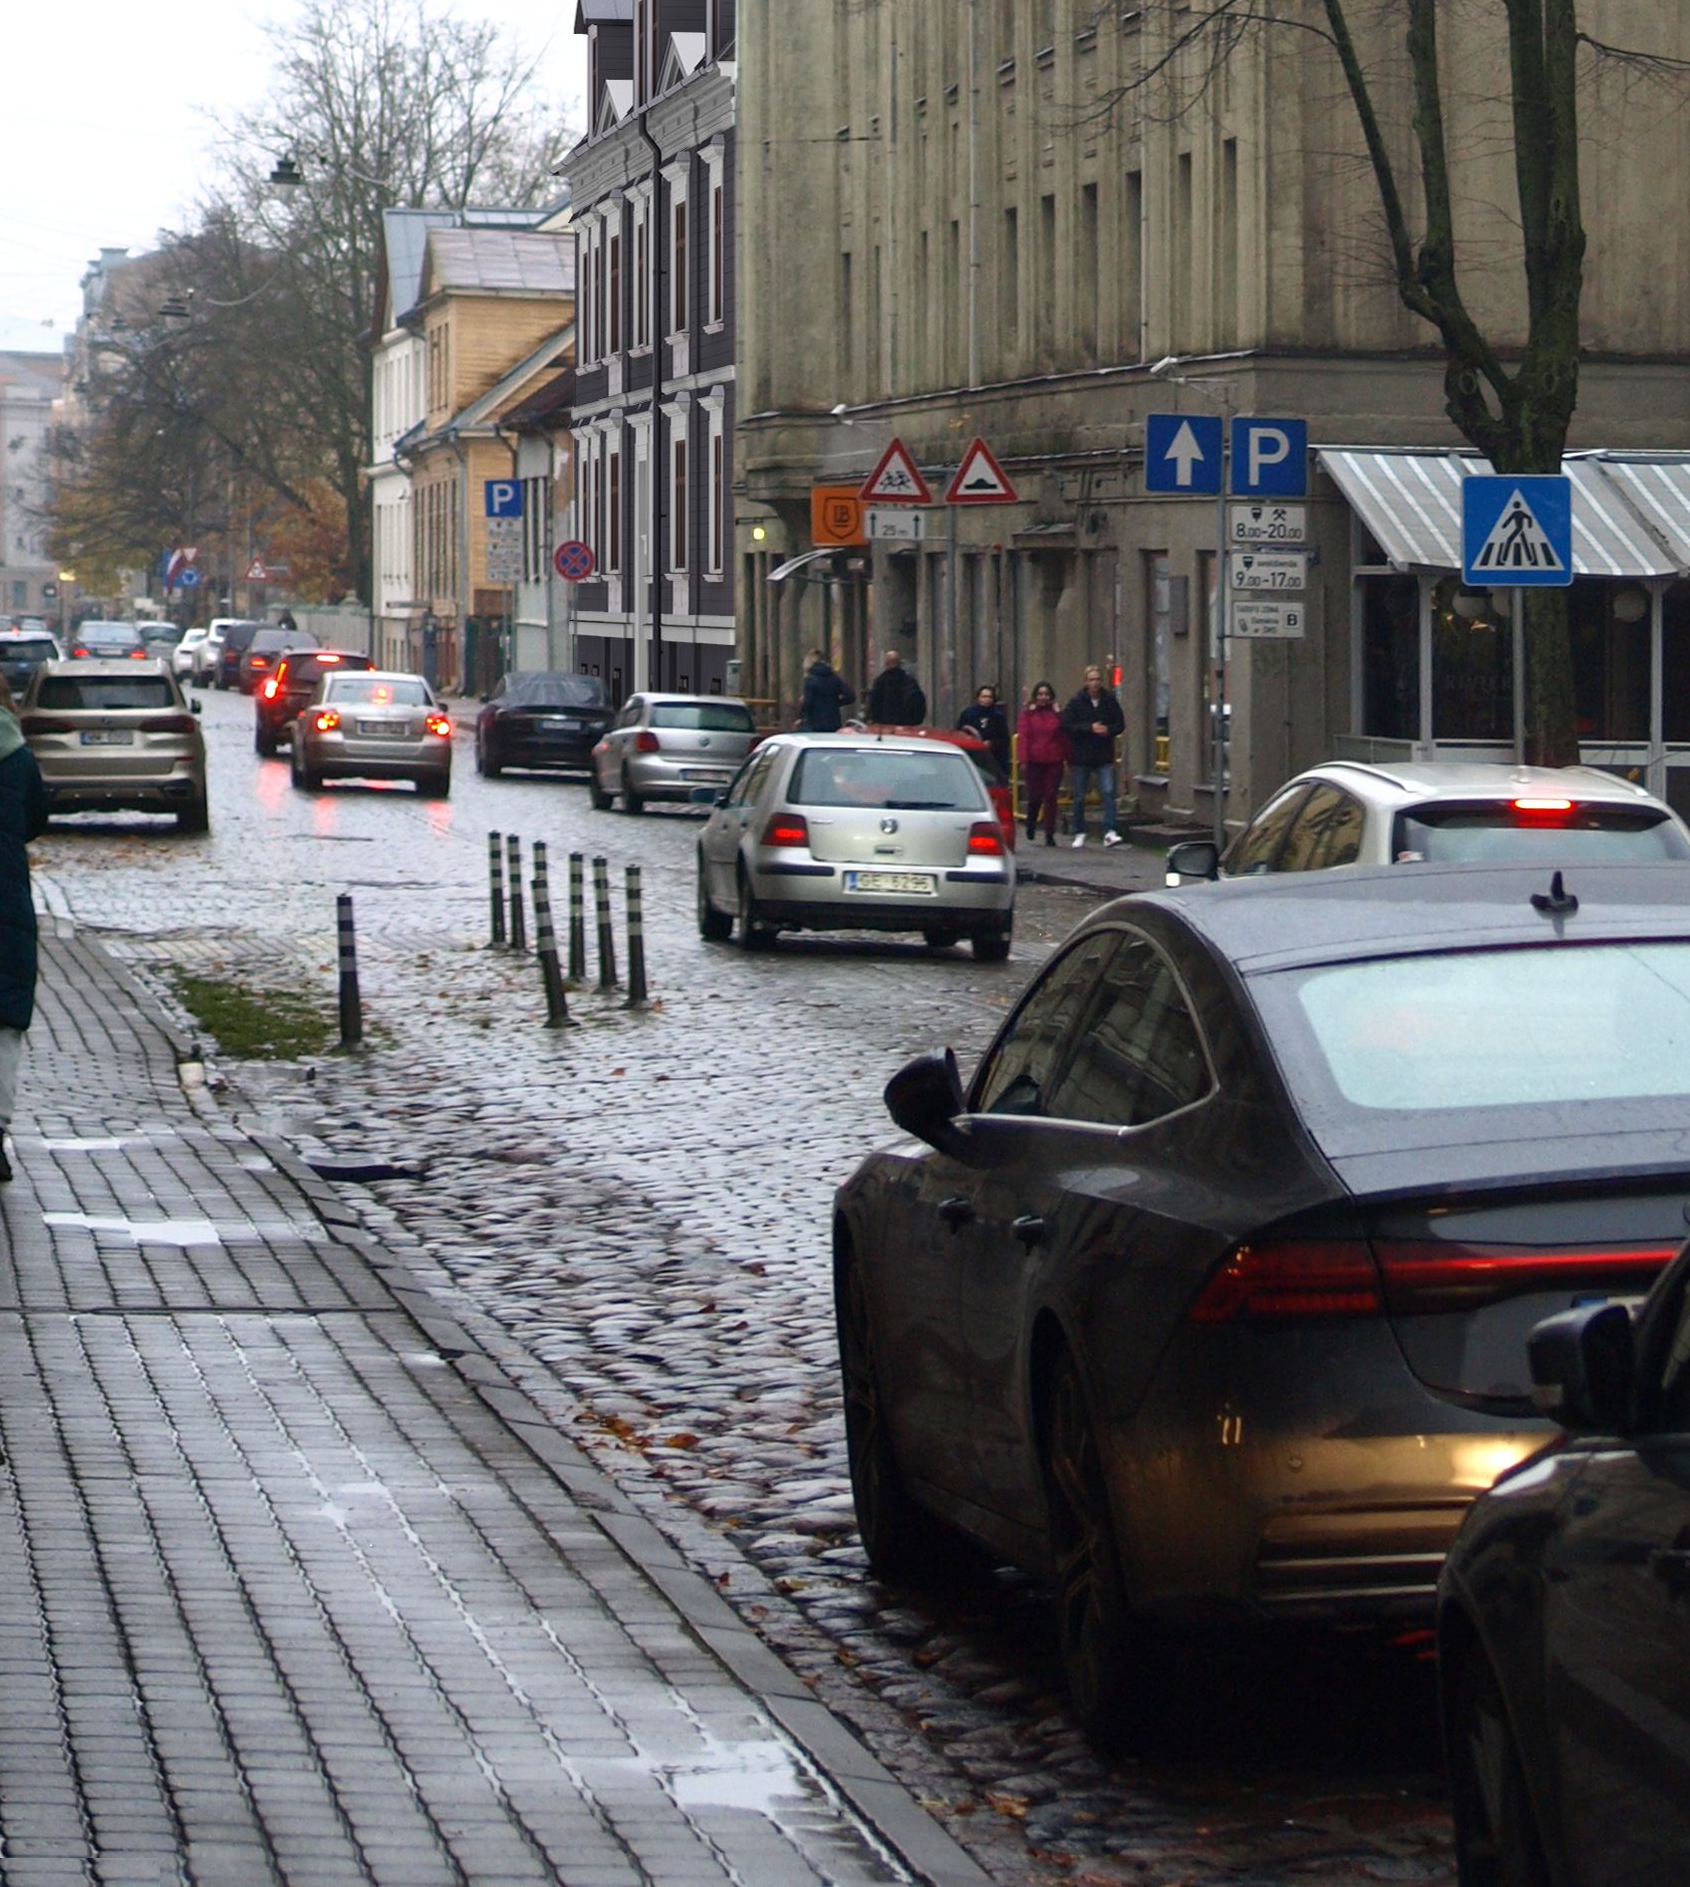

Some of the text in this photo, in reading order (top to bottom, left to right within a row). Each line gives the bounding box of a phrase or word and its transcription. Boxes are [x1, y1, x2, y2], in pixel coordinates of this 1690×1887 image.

[1248, 427, 1290, 486] P
[492, 484, 514, 513] P
[882, 525, 897, 536] 25
[1236, 522, 1302, 539] 8.00-20.00
[1236, 571, 1301, 587] 9.00-17.00
[1287, 614, 1298, 626] B
